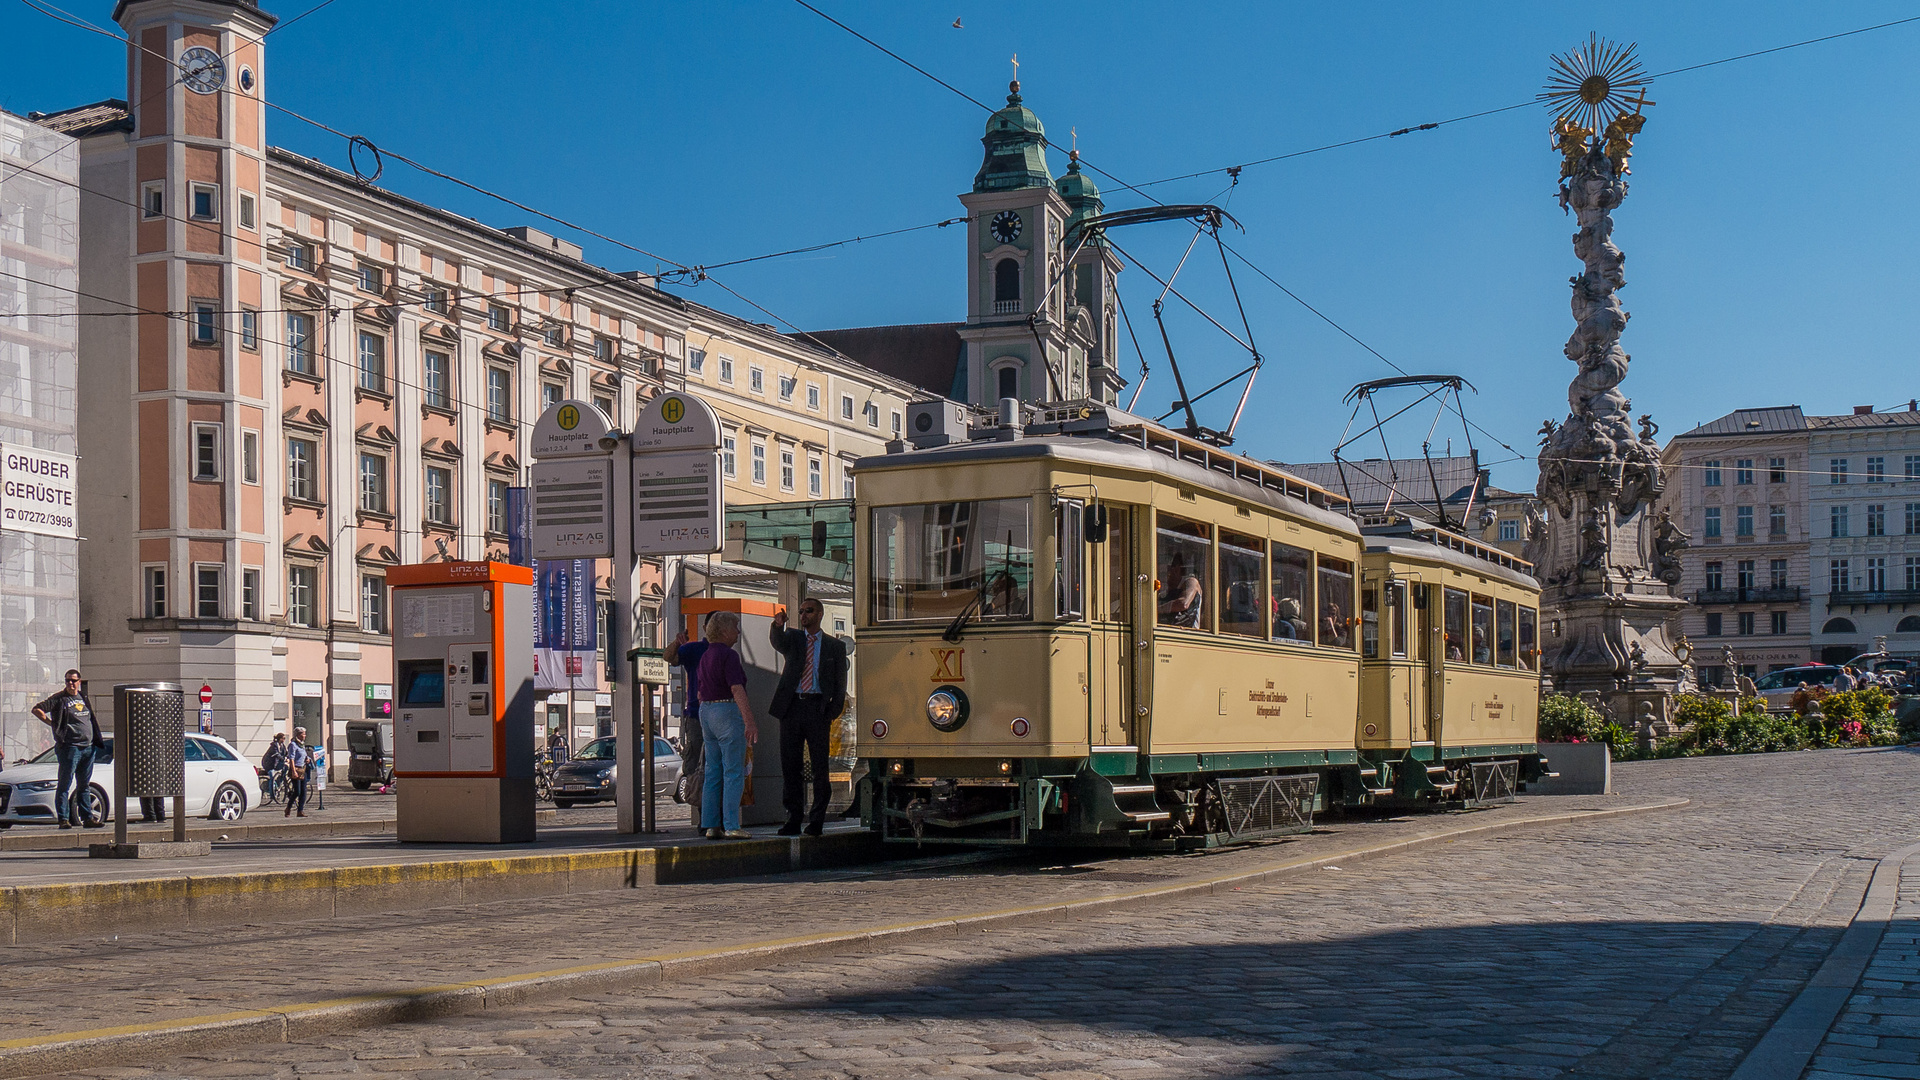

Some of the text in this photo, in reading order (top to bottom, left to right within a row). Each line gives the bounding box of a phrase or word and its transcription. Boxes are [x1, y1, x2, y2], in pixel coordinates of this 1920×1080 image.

[652, 426, 694, 435] Hauptplatz
[549, 433, 588, 442] Hauptplatz
[8, 454, 69, 479] GRUBER
[5, 481, 72, 506] GERÜSTE
[18, 510, 72, 528] 07272/3998
[661, 528, 688, 536] LINZ
[644, 660, 663, 668] Bergbahn
[930, 647, 965, 682] XI
